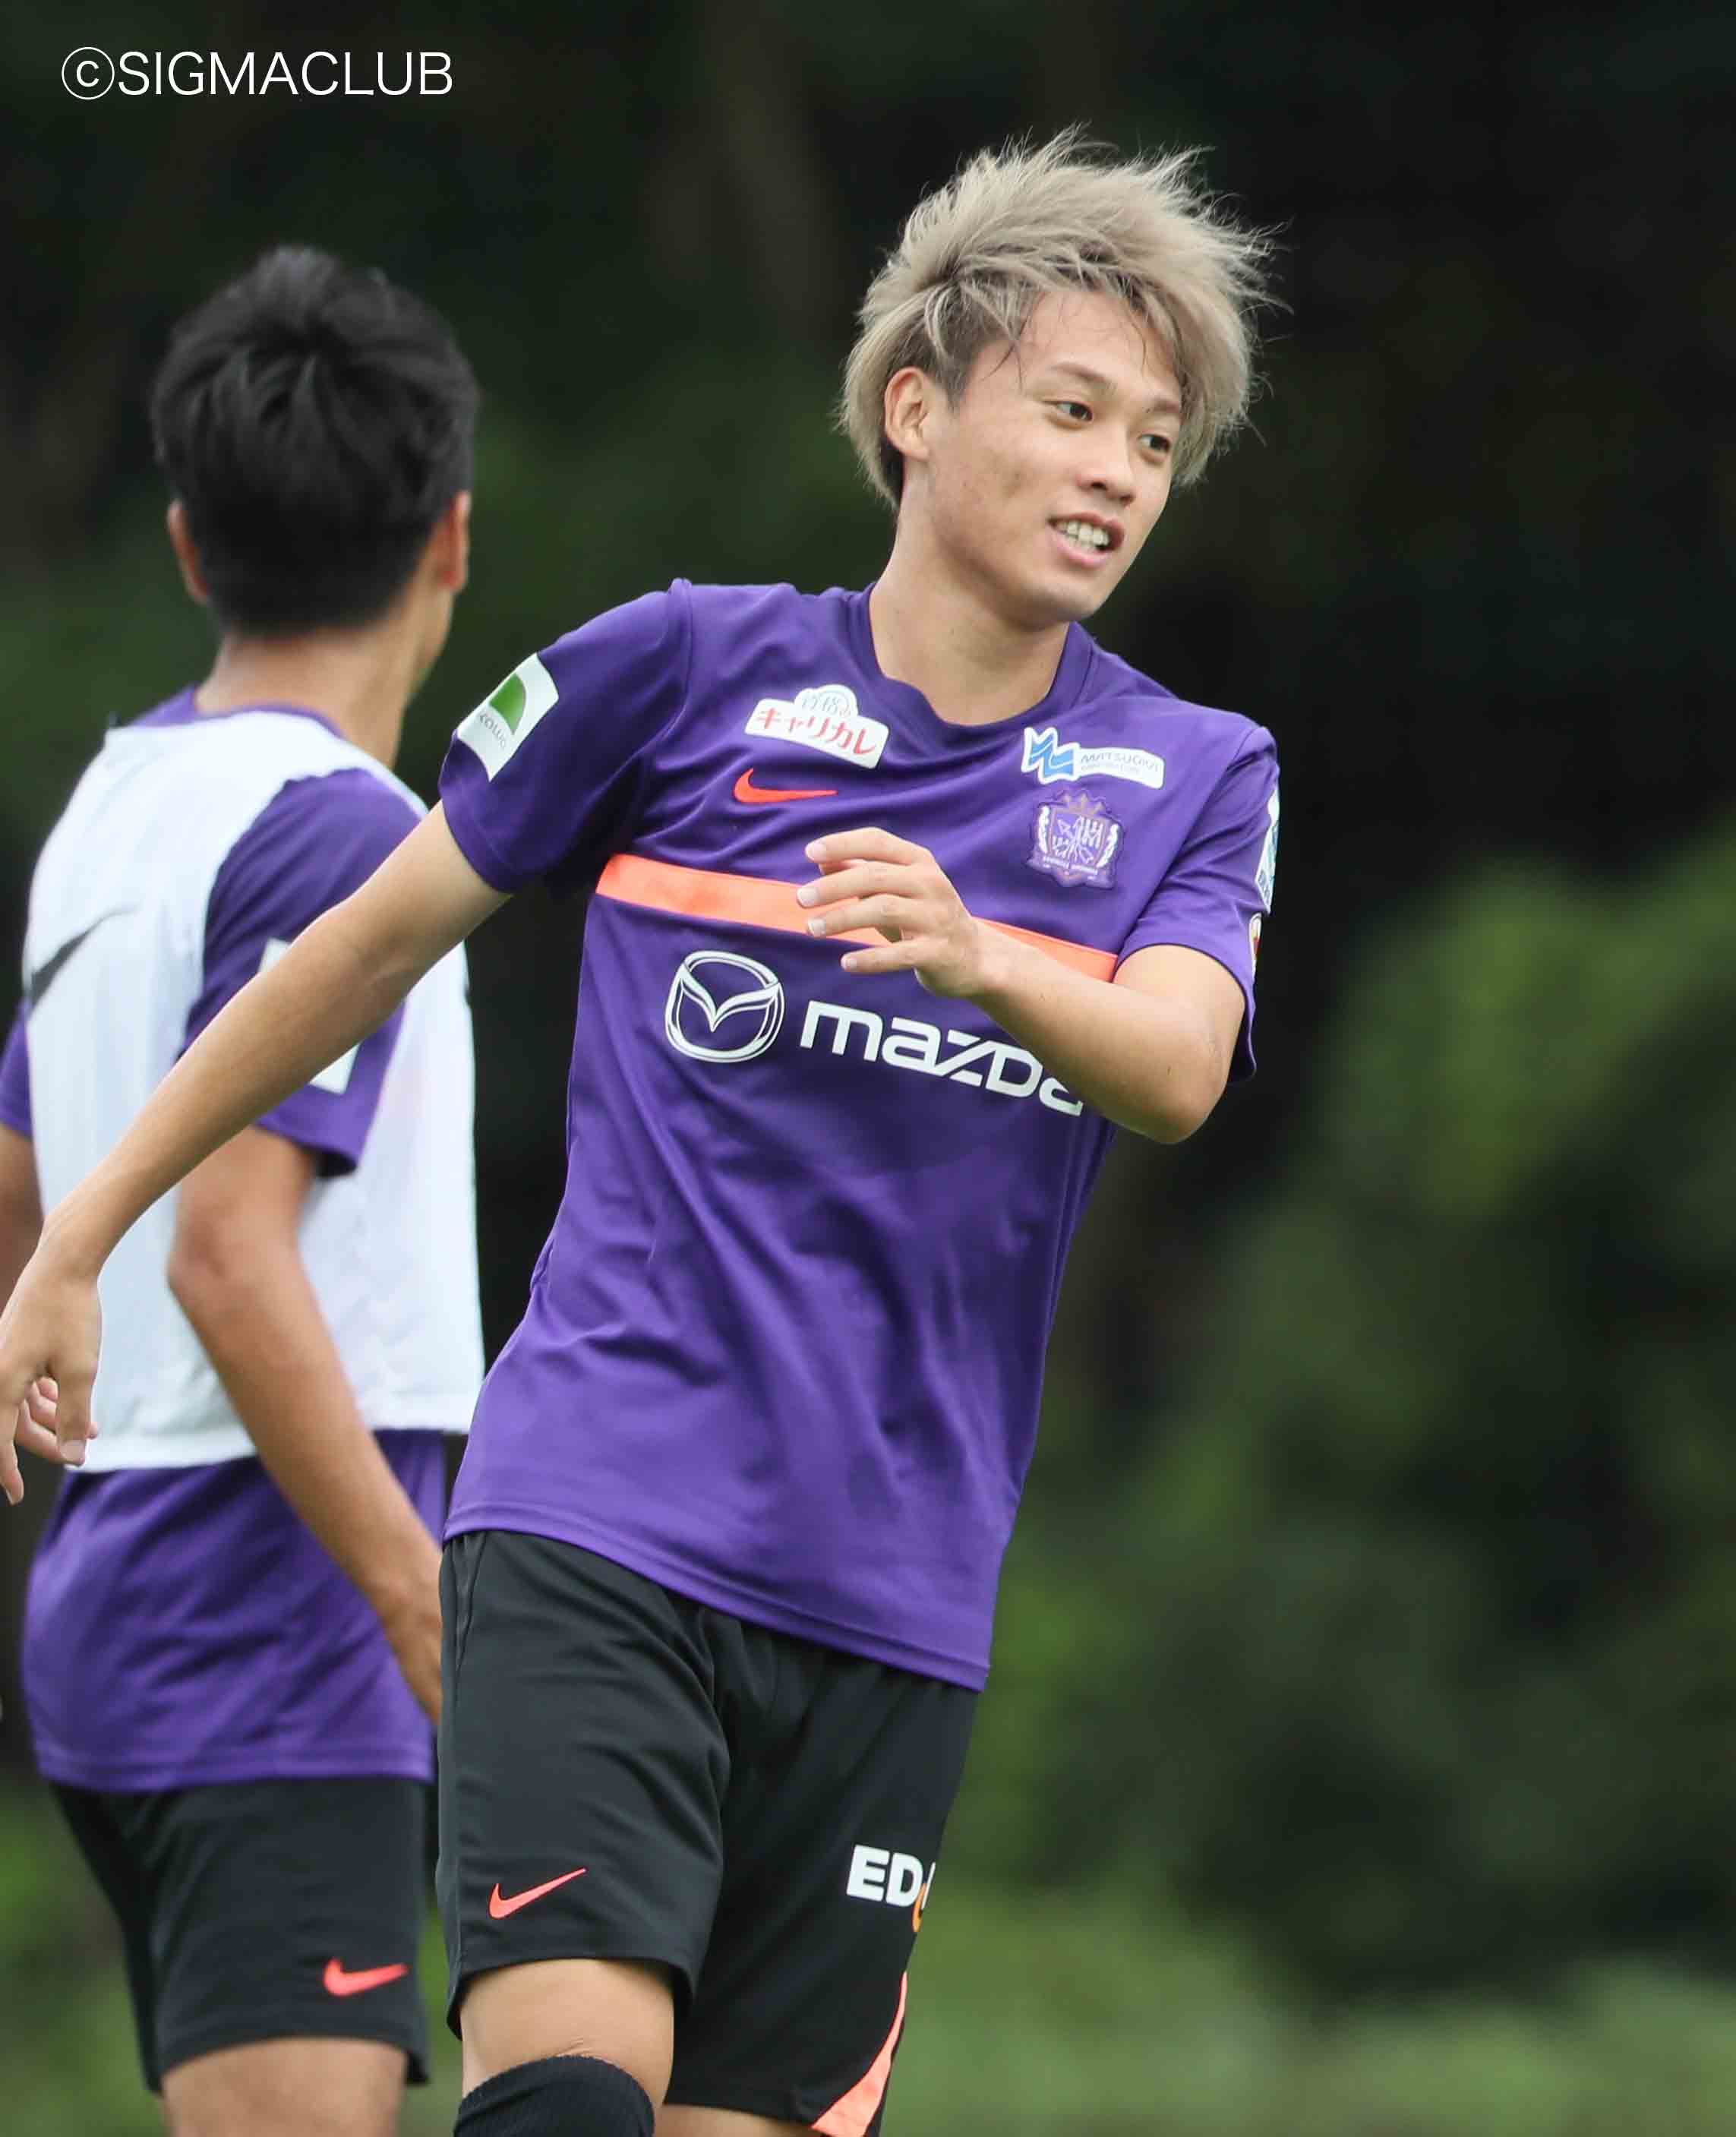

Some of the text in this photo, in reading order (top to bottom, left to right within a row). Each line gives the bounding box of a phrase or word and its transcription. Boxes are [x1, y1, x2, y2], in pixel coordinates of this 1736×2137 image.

[756, 707, 876, 755] キャリカレ
[846, 1844, 936, 1910] ED
